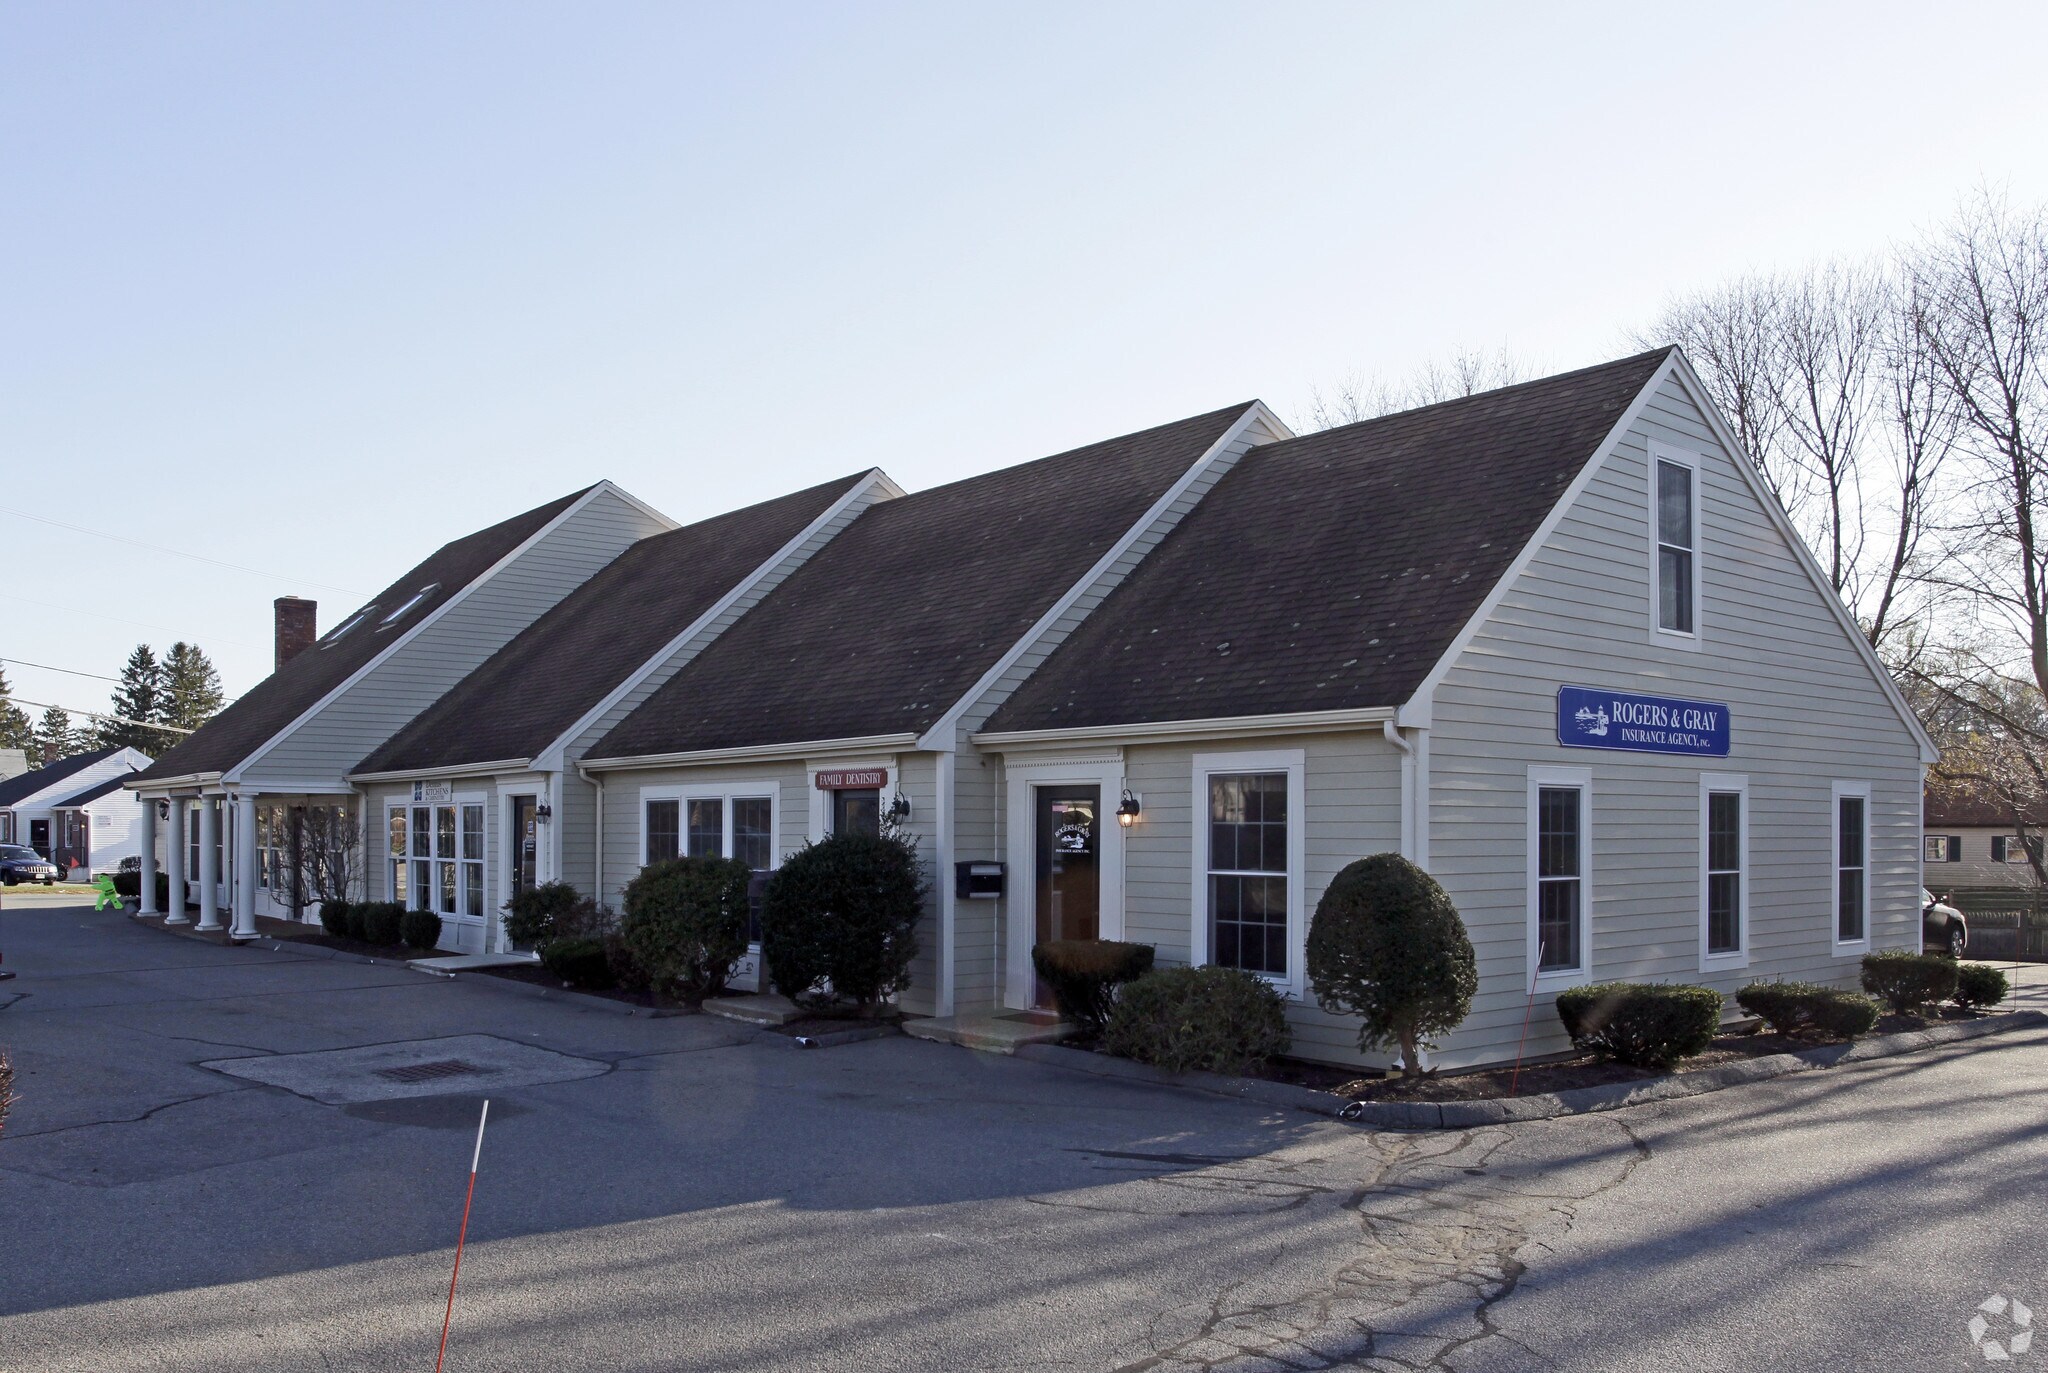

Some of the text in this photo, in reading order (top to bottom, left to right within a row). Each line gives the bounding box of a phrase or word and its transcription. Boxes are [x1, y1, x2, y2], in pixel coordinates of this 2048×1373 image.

[1612, 701, 1718, 731] ROGERS & GRAY
[1621, 728, 1711, 748] INSURANCE AGENCY, INC.
[820, 772, 882, 786] FAMILY DENTISTRY
[425, 788, 449, 796] KITCHENS
